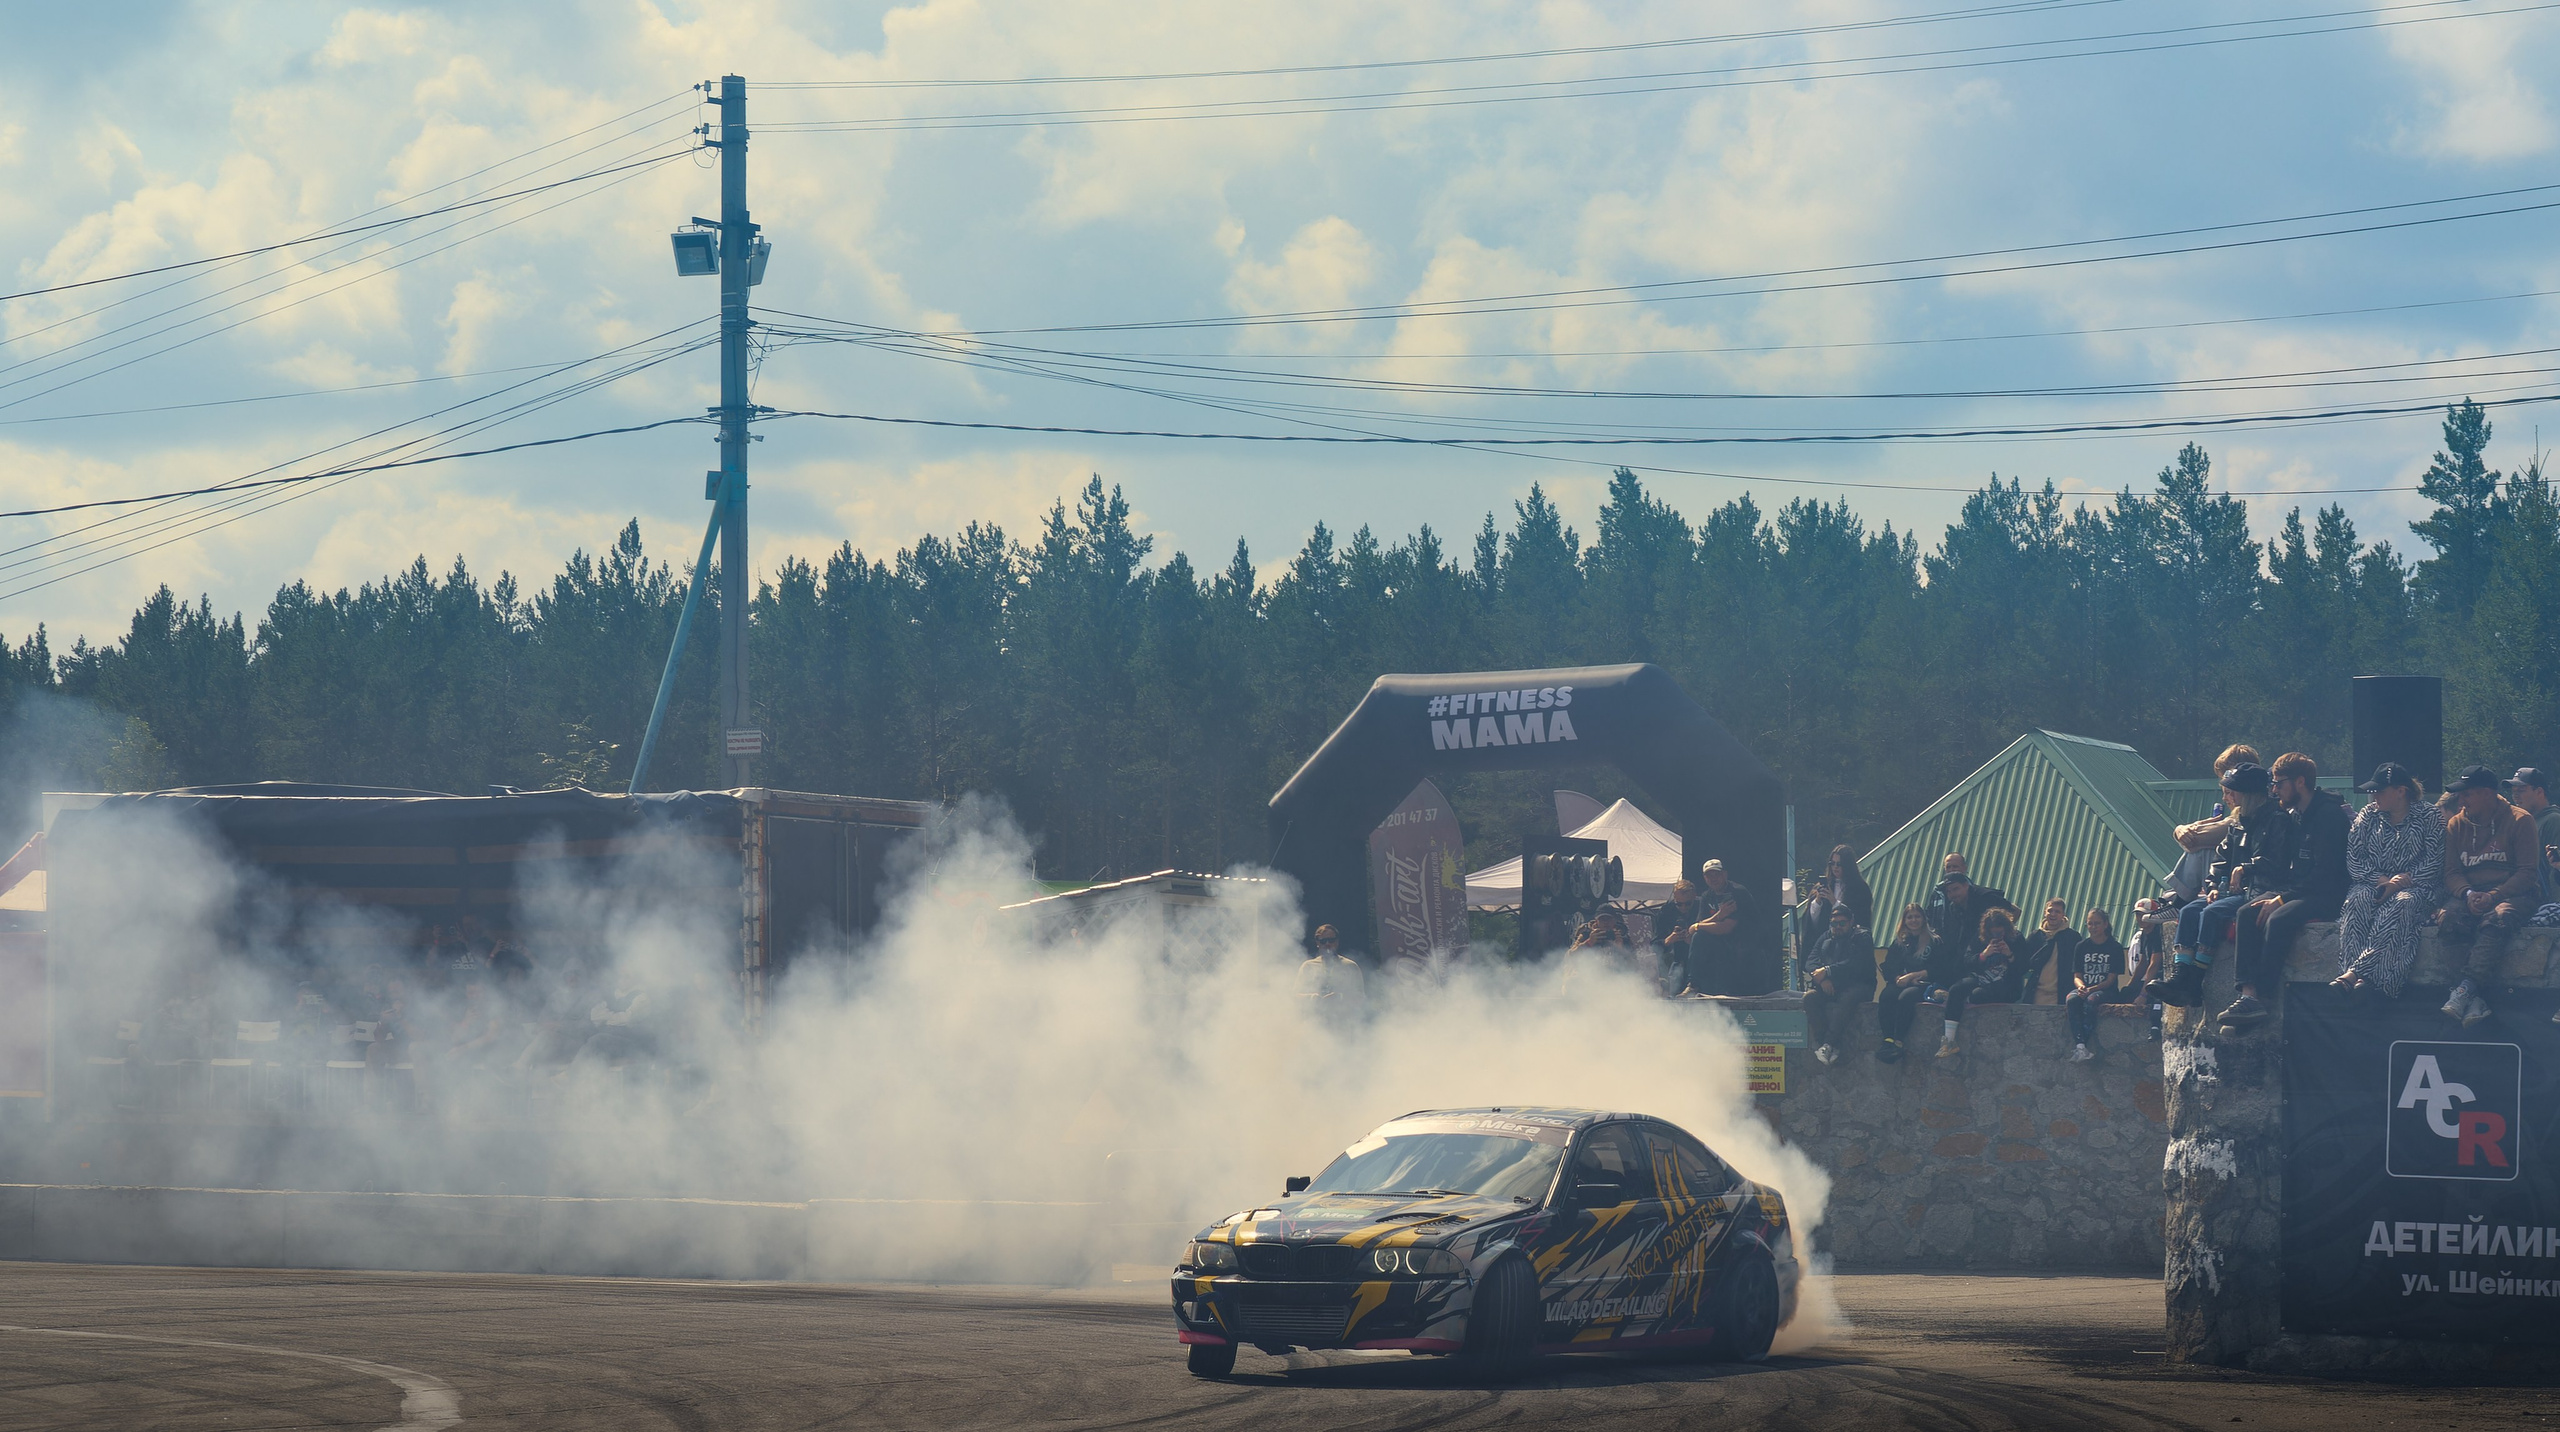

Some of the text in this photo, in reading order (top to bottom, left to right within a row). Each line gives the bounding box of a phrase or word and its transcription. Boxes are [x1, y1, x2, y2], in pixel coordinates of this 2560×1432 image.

[1427, 686, 1574, 717] #FITNESS
[1431, 710, 1578, 750] MAMA
[1388, 812, 1406, 828] 201
[1409, 809, 1422, 823] 47
[1425, 808, 1438, 822] 37
[1431, 851, 1439, 879] ДИСКОВ
[1433, 879, 1442, 910] РЕМОНТА
[2084, 953, 2110, 963] BEST
[2397, 1055, 2509, 1167] ACR
[1663, 1216, 1698, 1259] DRIFT
[1694, 1196, 1728, 1233] TEAM
[2401, 1273, 2439, 1297] ул.
[1544, 1293, 1668, 1322] VILAR DETAILING
